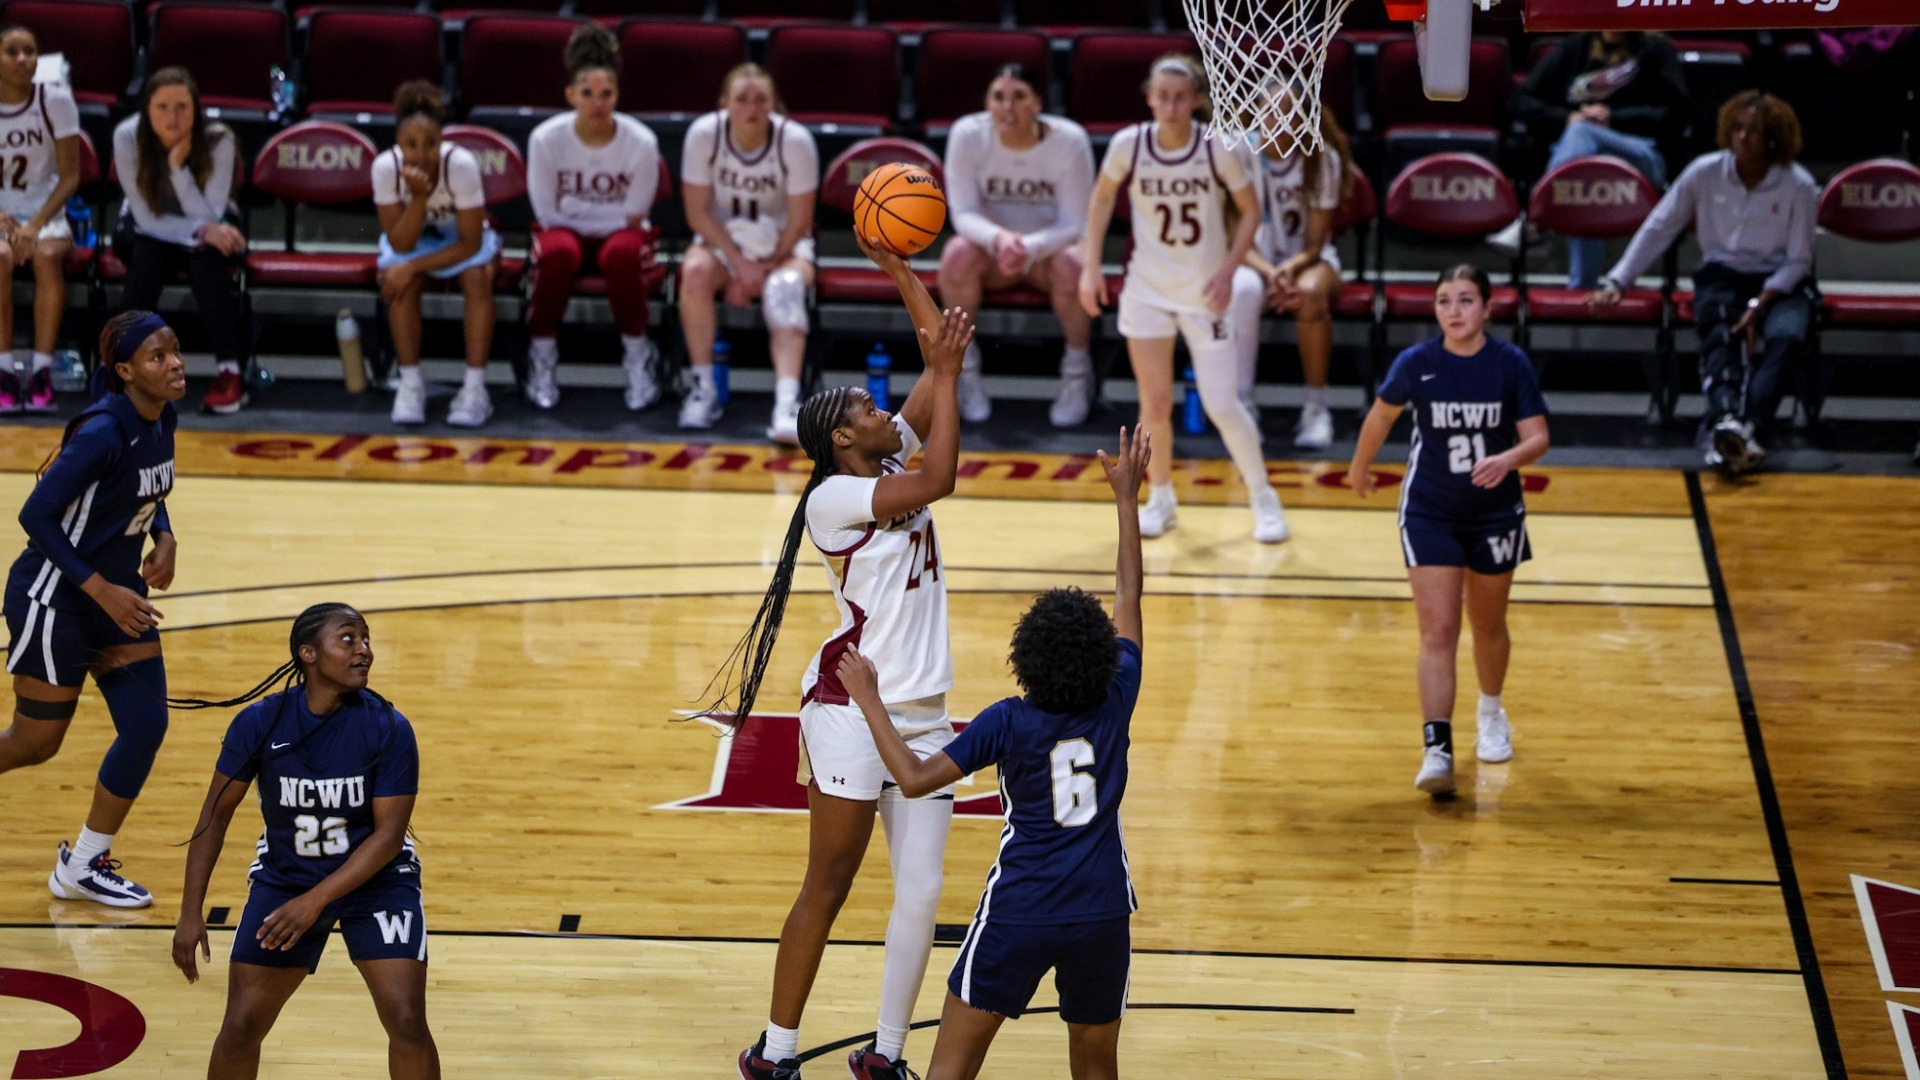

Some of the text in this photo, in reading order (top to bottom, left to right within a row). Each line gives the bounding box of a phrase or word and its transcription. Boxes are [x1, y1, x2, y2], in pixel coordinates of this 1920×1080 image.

[277, 145, 362, 171] ELON
[556, 170, 635, 197] ELON
[718, 164, 777, 193] ELON
[986, 177, 1057, 197] ELON
[1141, 177, 1210, 197] ELON
[1411, 175, 1495, 201] ELON
[1552, 179, 1639, 206] ELON
[1155, 203, 1201, 247] 25
[1212, 321, 1228, 341] E
[1430, 402, 1502, 429] NCWU
[1447, 433, 1487, 475] 21
[906, 519, 939, 590] 24
[1487, 529, 1518, 565] W
[279, 775, 366, 809] NCWU
[1049, 737, 1098, 828] 6
[294, 814, 350, 858] 23
[373, 909, 414, 944] W
